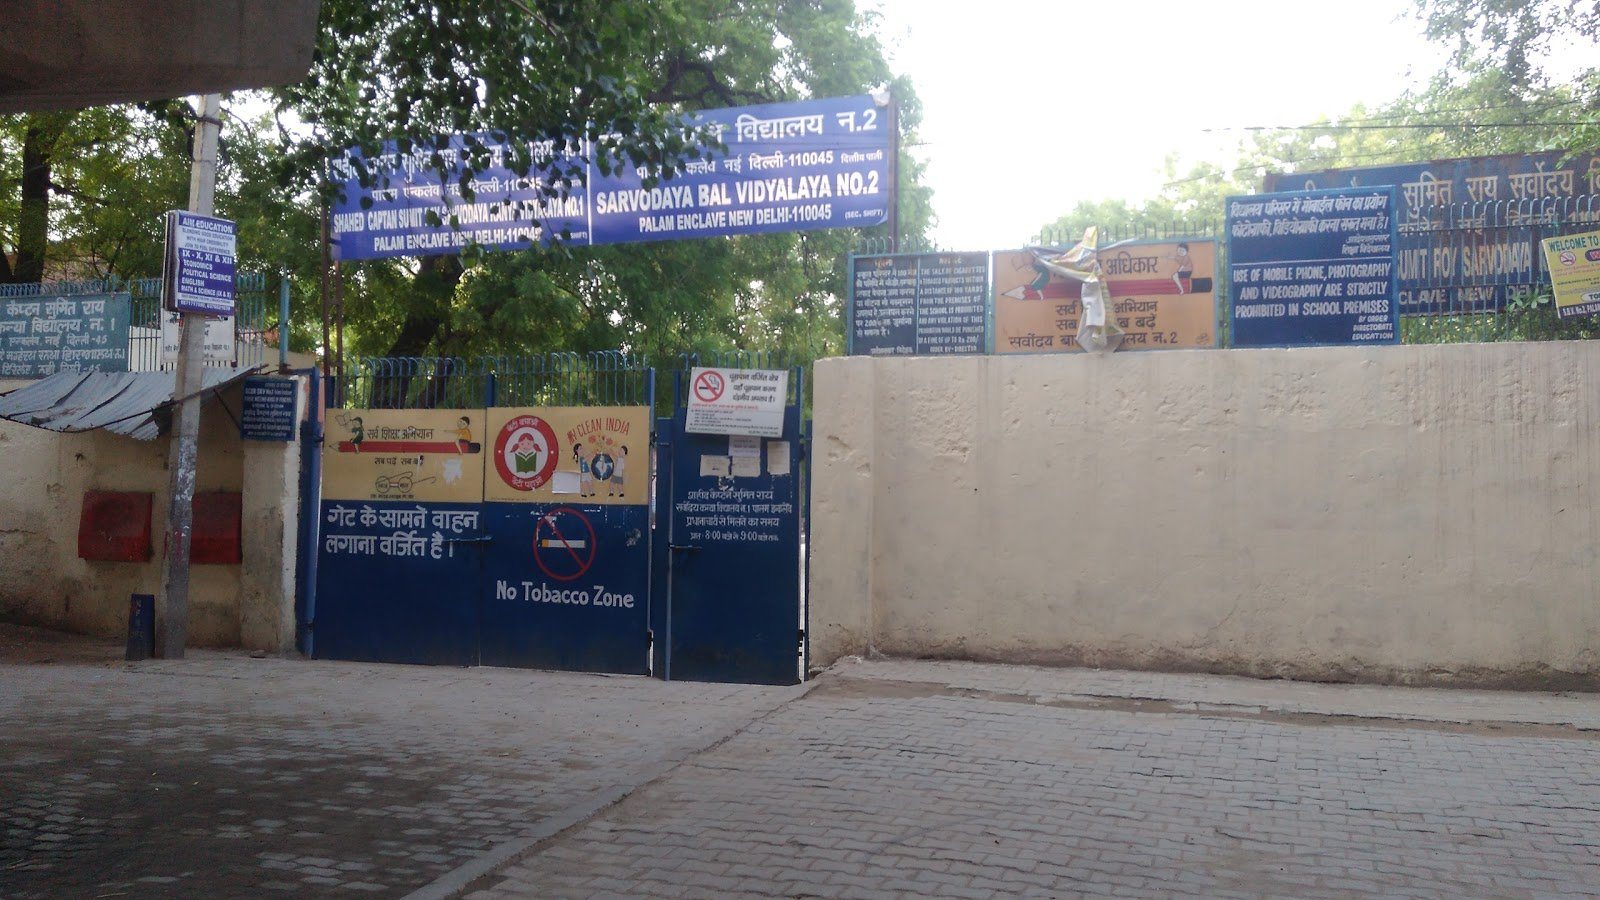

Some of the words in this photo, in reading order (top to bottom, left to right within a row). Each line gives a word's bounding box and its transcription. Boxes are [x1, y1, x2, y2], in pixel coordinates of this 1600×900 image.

[735, 112, 824, 143] विद्यालय
[724, 156, 741, 174] नई
[749, 150, 833, 171] दिल्ली-110045
[596, 184, 694, 214] SARVODAYA
[700, 182, 731, 208] BAL
[736, 175, 832, 204] VIDYALAYA
[837, 170, 879, 198] NO.2
[1402, 171, 1453, 218] सुमित
[1465, 175, 1498, 201] राय
[1508, 160, 1574, 199] सर्वोदय
[183, 217, 195, 228] AIM
[196, 219, 233, 234] EDUCATION
[334, 212, 364, 233] SHAHED
[399, 207, 421, 228] SUMIT
[639, 214, 675, 233] PALAM
[677, 210, 727, 231] ENCLAVE
[729, 207, 754, 228] NEW
[756, 203, 832, 225] DELHI-110045
[374, 236, 405, 251] PALAM
[406, 232, 451, 250] ENCLAVE
[1549, 237, 1587, 252] WELCOME
[1588, 235, 1599, 246] TO
[182, 249, 190, 257] IX
[222, 256, 232, 265] XII
[183, 259, 212, 271] ECONOMICS
[1106, 251, 1158, 275] अधिकार
[181, 277, 205, 287] ENGLISH
[182, 268, 208, 278] POLITICAL
[209, 272, 232, 282] SCIENCE
[1233, 268, 1248, 282] USE
[1250, 268, 1261, 282] OF
[1263, 266, 1293, 281] MOBILE
[1328, 263, 1391, 279] PHOTOGRAPHY
[198, 288, 216, 297] SCIENCE
[1240, 287, 1259, 300] AND
[1262, 284, 1323, 300] VIDEOGRAPHY
[1324, 283, 1342, 297] ARE
[1346, 281, 1388, 296] STRICTLY
[45, 297, 77, 320] सुमित
[82, 301, 106, 315] राय
[1056, 300, 1077, 316] सर्व
[1114, 299, 1158, 314] अभियान
[1235, 303, 1285, 318] PROHIBITED
[1288, 303, 1299, 316] IN
[1303, 301, 1341, 316] SCHOOL
[1343, 299, 1389, 314] PREMISES
[31, 316, 82, 334] विद्यालय
[1056, 319, 1078, 331] सब
[1367, 314, 1388, 322] ORDER
[1008, 332, 1055, 348] सर्वोदय
[1060, 335, 1078, 347] बा
[1352, 332, 1393, 341] EDUCATION
[566, 429, 577, 445] MY
[577, 418, 602, 438] CLEAN
[605, 418, 630, 436] INDIA
[733, 489, 755, 503] सुमित
[756, 490, 773, 500] राय
[328, 505, 356, 527] गेट
[360, 505, 377, 526] के
[379, 505, 427, 528] सामने
[432, 511, 479, 534] वाहन
[727, 515, 747, 526] मिलने
[748, 517, 759, 526] का
[760, 517, 780, 526] समय
[326, 535, 378, 555] लगाना
[380, 530, 427, 556] वर्जित
[496, 580, 517, 600] No
[521, 581, 589, 605] Tobacco
[592, 585, 635, 608] Zone
